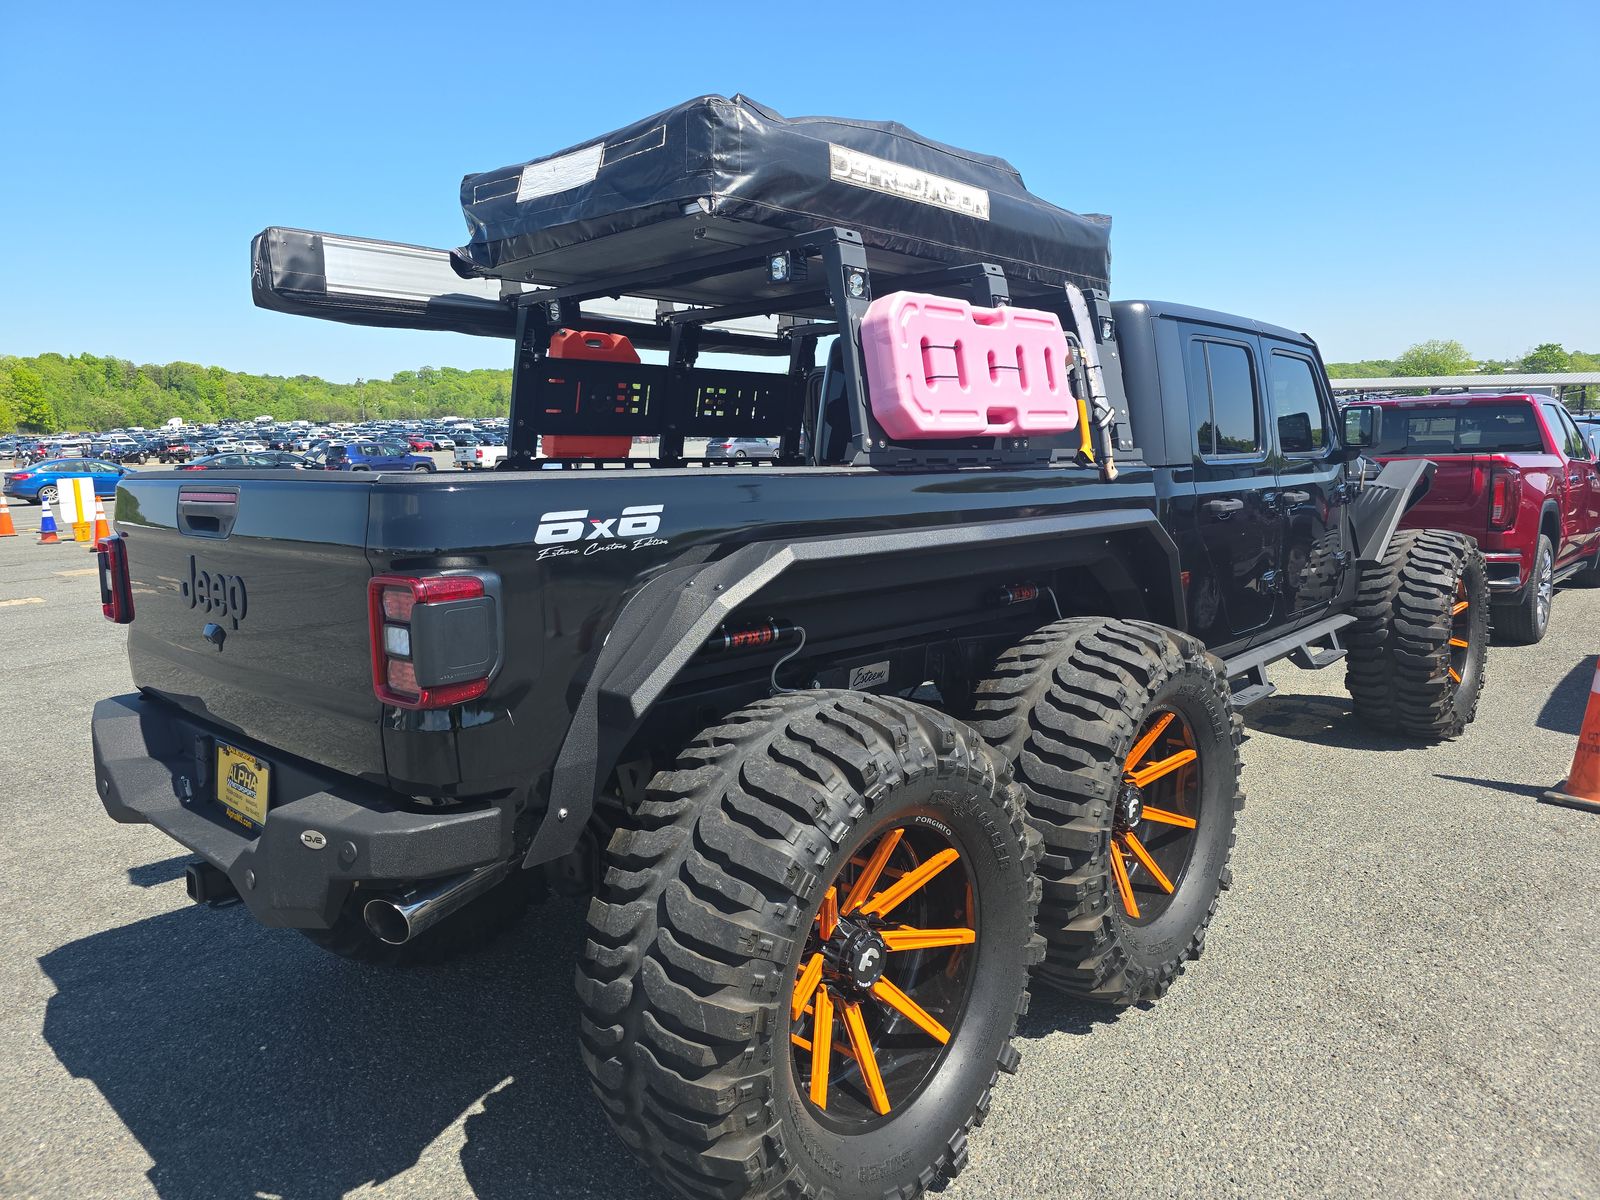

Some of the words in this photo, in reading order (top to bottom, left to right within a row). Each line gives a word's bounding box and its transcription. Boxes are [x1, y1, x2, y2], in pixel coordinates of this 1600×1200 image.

[534, 504, 664, 545] 6x6
[583, 542, 628, 556] Custom
[631, 536, 669, 551] Edition
[180, 554, 247, 630] Jeep
[853, 667, 886, 687] Esteem
[228, 765, 257, 790] ALPHA
[915, 815, 952, 836] FORGIATO
